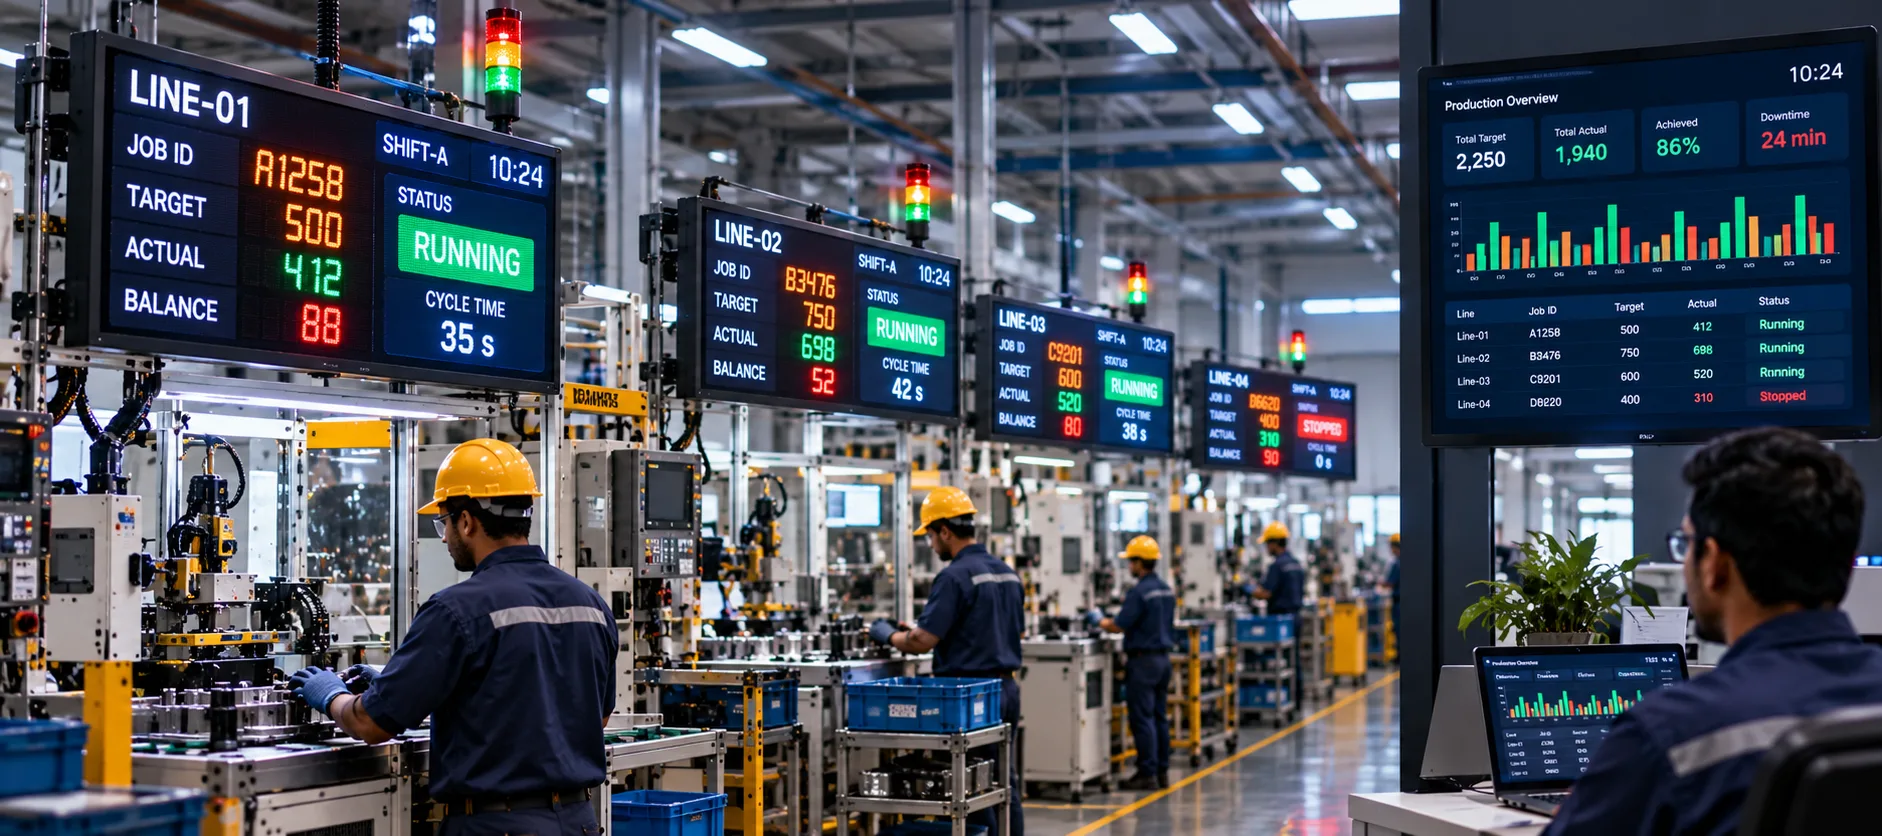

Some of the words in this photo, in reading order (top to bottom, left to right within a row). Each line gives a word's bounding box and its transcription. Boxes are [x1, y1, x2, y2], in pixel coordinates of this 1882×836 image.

[1790, 63, 1843, 82] 10:24
[131, 66, 253, 128] LINE-01
[1446, 98, 1503, 111] Production
[1507, 93, 1558, 106] Overview
[1656, 118, 1697, 129] Achieved
[1761, 110, 1809, 121] Downtime
[1456, 135, 1476, 144] Total
[1479, 134, 1506, 143] Target
[1555, 127, 1576, 136] Total
[1579, 125, 1606, 135] Actual
[1762, 131, 1786, 148] 24
[1792, 129, 1826, 146] min
[127, 134, 167, 160] JOB
[174, 142, 193, 165] ID
[383, 133, 448, 166] SHIFT-A
[1556, 144, 1607, 165] 1,940
[1657, 137, 1700, 156] 86%
[490, 155, 543, 188] 10:24
[1457, 151, 1505, 172] 2,250
[255, 149, 343, 205] A1258
[127, 184, 206, 218] TARGET
[398, 186, 452, 216] STATUS
[286, 204, 342, 248] 500
[715, 219, 781, 253] LINE-02
[125, 236, 205, 269] ACTUAL
[415, 231, 520, 276] RUNNING
[714, 260, 736, 277] JOB
[740, 265, 750, 279] ID
[859, 254, 896, 274] SHIFT-A
[284, 253, 342, 296] 412
[786, 266, 835, 299] B3476
[919, 264, 950, 287] 10:24
[125, 288, 218, 322] BALANCE
[426, 290, 470, 312] CYCLE
[474, 298, 505, 318] TIME
[714, 292, 758, 313] TARGET
[867, 288, 898, 305] STATUS
[804, 301, 835, 330] 750
[1457, 310, 1474, 318] Line
[1529, 307, 1545, 315] Job
[1548, 306, 1557, 314] ID
[1615, 302, 1644, 313] Target
[1688, 299, 1716, 308] Actual
[1759, 297, 1789, 305] Status
[301, 304, 342, 345] 88
[999, 309, 1045, 333] LINE-03
[1458, 331, 1488, 340] Line-01
[1530, 328, 1560, 337] A1258
[1621, 325, 1639, 334] 500
[1693, 322, 1711, 331] 412
[1760, 319, 1804, 330] Running
[441, 320, 474, 354] 35
[481, 335, 494, 357] s
[714, 326, 757, 346] ACTUAL
[877, 318, 937, 346] RUNNING
[1098, 330, 1126, 345] SHIFT-A
[802, 333, 835, 362] 698
[999, 339, 1015, 351] JOB
[1017, 341, 1025, 353] ID
[1048, 342, 1082, 365] C9201
[1142, 337, 1167, 353] 10:24
[1458, 354, 1489, 363] Line-02
[1530, 351, 1560, 360] B3476
[1621, 348, 1639, 357] 750
[1694, 345, 1712, 355] 698
[1760, 342, 1804, 354] Running
[714, 360, 765, 380] BALANCE
[883, 357, 909, 372] CYCLE
[911, 361, 929, 375] TIME
[1000, 362, 1031, 377] TARGET
[1104, 355, 1128, 368] STATUS
[812, 367, 835, 395] 52
[1058, 368, 1081, 389] 600
[1209, 370, 1249, 388] LINE-04
[1458, 377, 1490, 386] Line-03
[1530, 375, 1560, 384] C9201
[1621, 372, 1639, 381] 600
[1694, 369, 1713, 378] 520
[892, 377, 912, 400] 42
[915, 386, 923, 401] s
[999, 387, 1030, 402] ACTUAL
[1112, 378, 1157, 399] RUNNING
[1330, 388, 1350, 400] 10:24
[1058, 392, 1081, 412] 520
[1458, 400, 1490, 409] Line-04
[1621, 395, 1640, 404] 400
[1695, 393, 1713, 402] 310
[1761, 390, 1806, 402] Stopped
[999, 412, 1036, 428] BALANCE
[1210, 409, 1236, 422] TARGET
[1259, 413, 1280, 430] 400
[1064, 416, 1082, 436] 80
[1140, 429, 1147, 441] s
[1210, 429, 1236, 440] ACTUAL
[1259, 431, 1280, 448] 310
[1209, 447, 1240, 460] BALANCE
[1263, 449, 1280, 466] 90
[1316, 454, 1324, 468] 0
[1324, 458, 1332, 469] s
